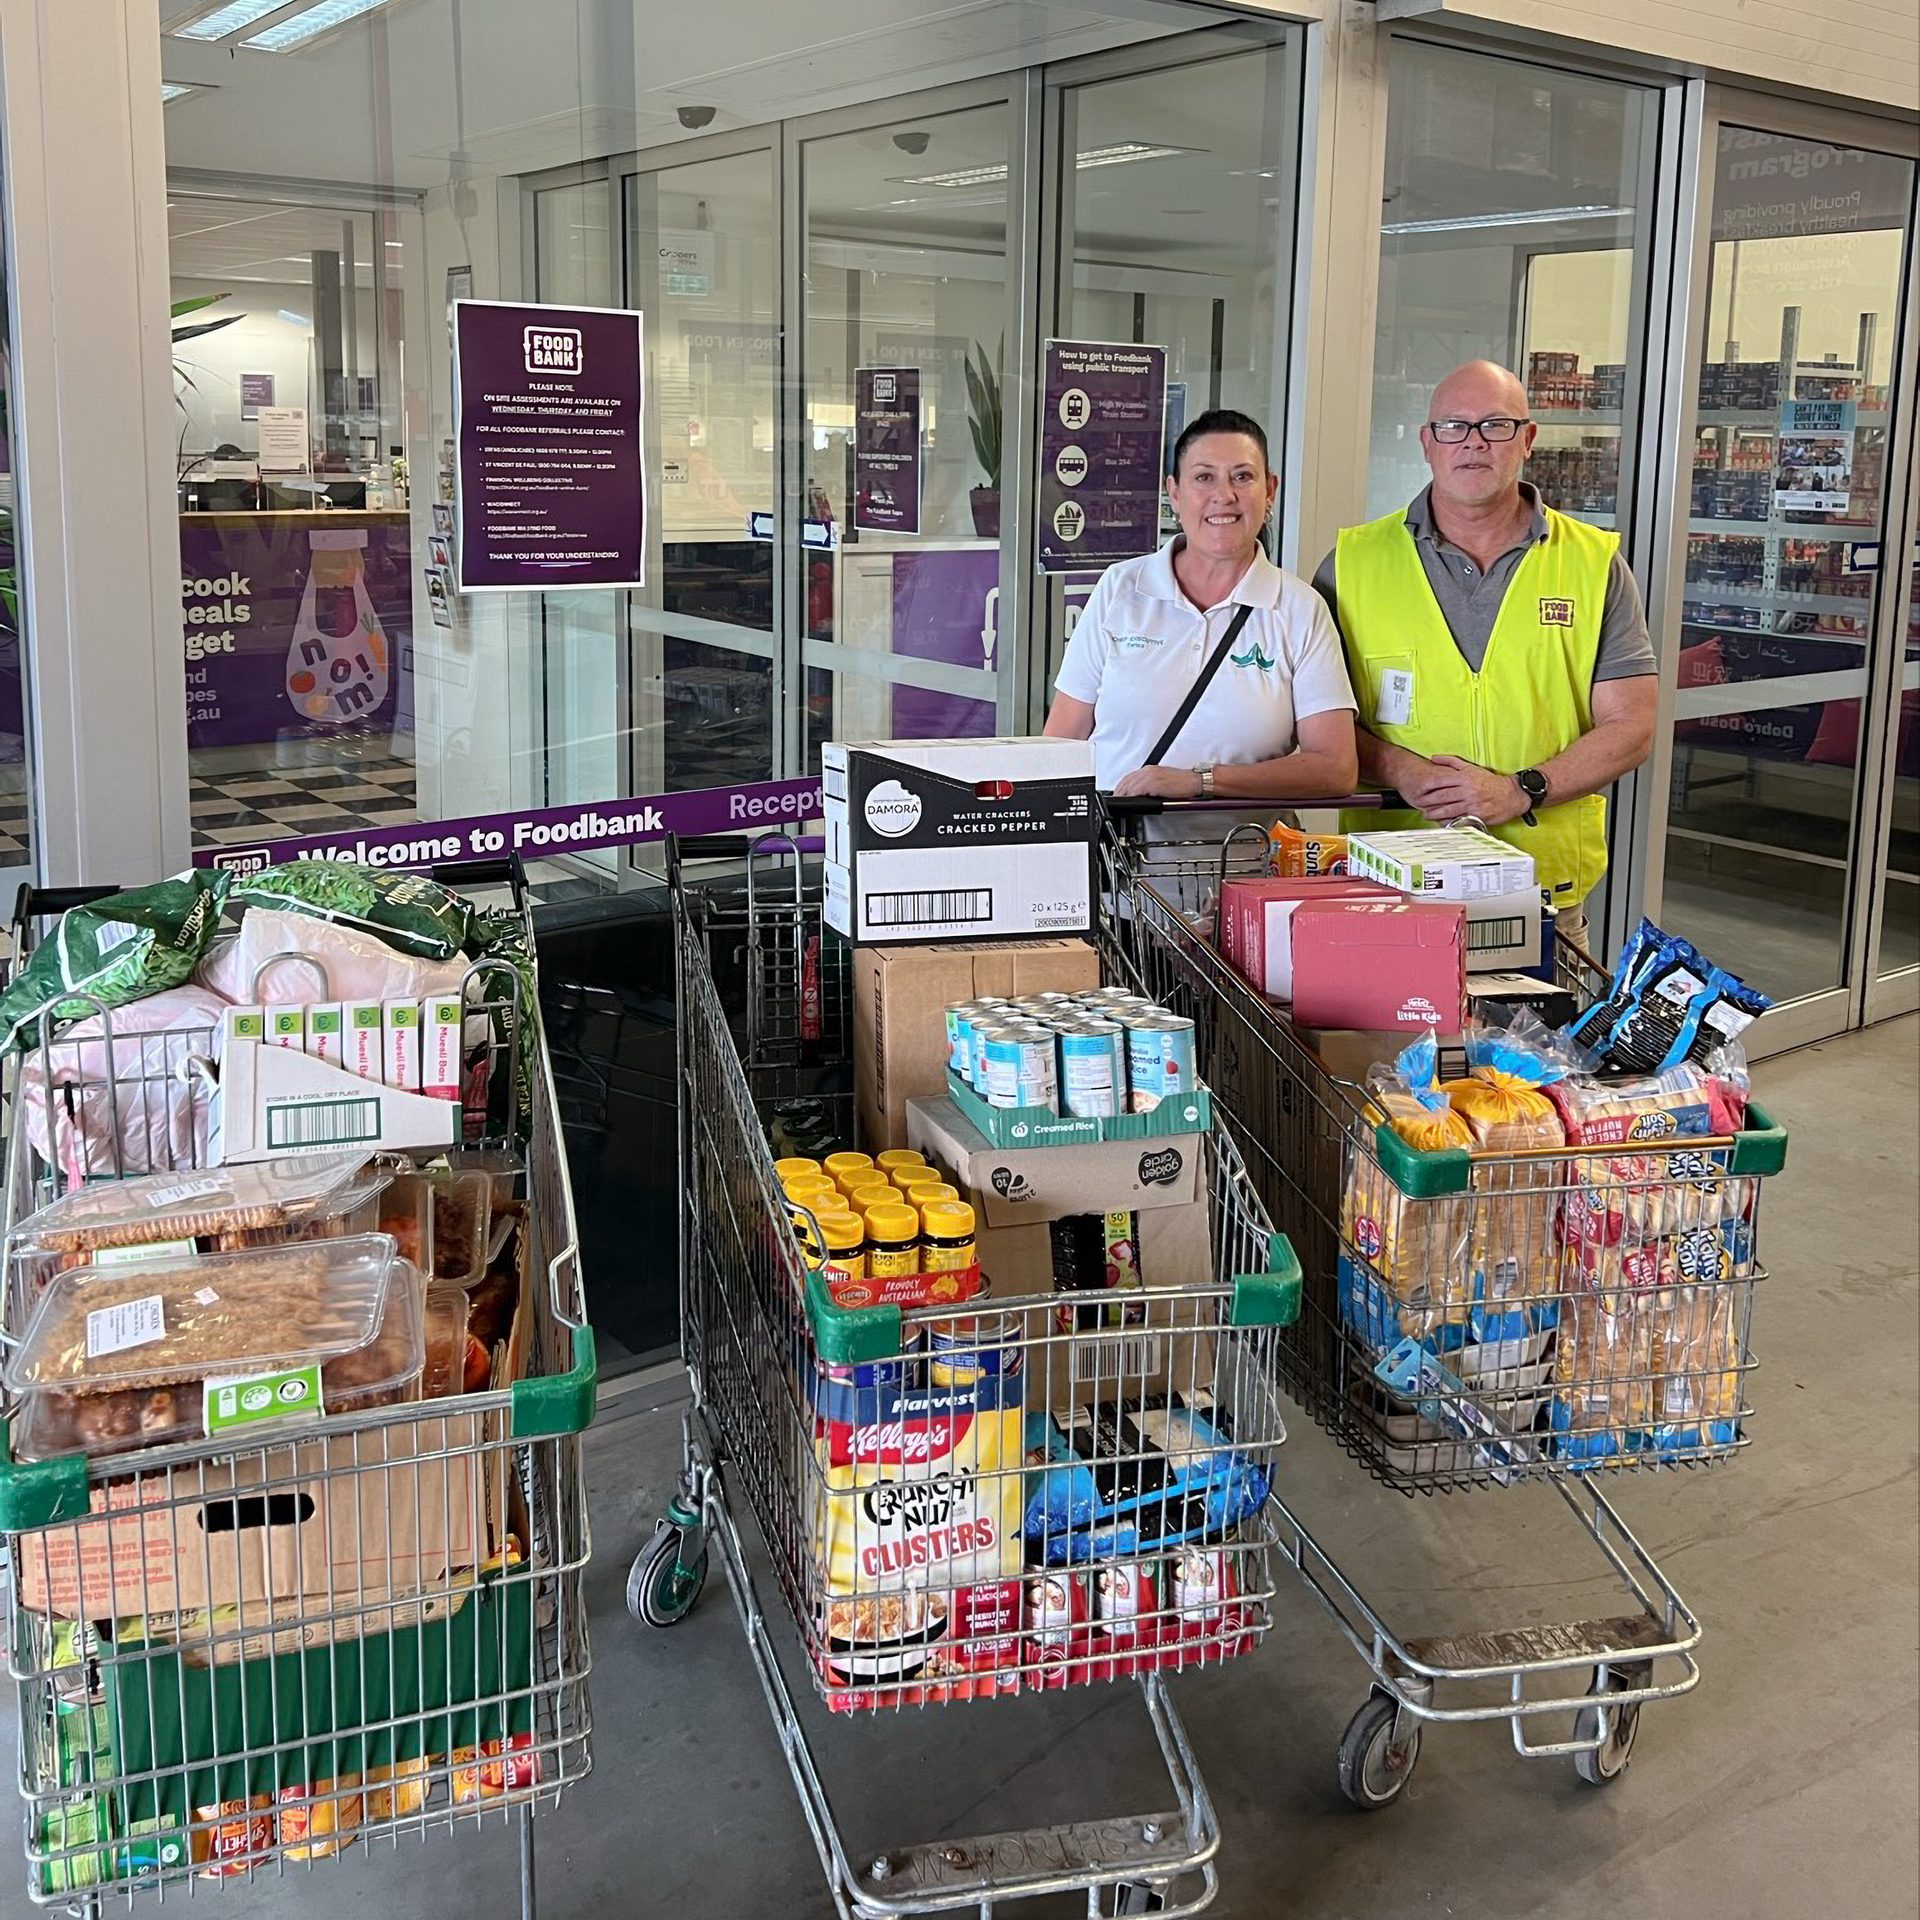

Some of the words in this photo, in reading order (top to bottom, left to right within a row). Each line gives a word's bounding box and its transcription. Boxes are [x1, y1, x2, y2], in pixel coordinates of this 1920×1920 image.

[533, 335, 573, 351] FOOD
[534, 350, 574, 367] BANK
[1059, 350, 1078, 359] How
[1079, 351, 1088, 360] to
[1089, 352, 1102, 362] get
[1104, 353, 1112, 361] to
[1114, 353, 1152, 363] Foodbank
[1062, 362, 1084, 373] using
[1085, 362, 1110, 373] public
[1111, 364, 1148, 375] transport
[181, 572, 251, 597] cook
[182, 599, 250, 625] eals
[1544, 602, 1568, 613] FOOD
[1545, 612, 1569, 622] BANK
[867, 804, 919, 815] DAMORA
[953, 812, 982, 820] WATER
[986, 810, 1031, 819] CRACKERS
[469, 828, 504, 853] to
[513, 806, 664, 847] Foodbank
[937, 823, 996, 834] CRACKED
[1001, 821, 1046, 832] PEPPER
[222, 856, 262, 872] FOOD
[1032, 903, 1044, 912] 20
[1054, 902, 1069, 911] 125
[1397, 1010, 1421, 1021] Little
[1421, 1011, 1442, 1024] Kids
[440, 1026, 449, 1061] Muesli
[1132, 1055, 1161, 1065] amed
[438, 1061, 448, 1083] Bars
[1034, 1124, 1074, 1134] Creamed
[1075, 1122, 1095, 1132] Rice
[1141, 1157, 1180, 1179] golden
[1144, 1153, 1173, 1168] circle
[885, 1279, 921, 1291] PROUDLY
[878, 1289, 926, 1303] AUSTRALIAN
[891, 1390, 976, 1414] Harvest
[848, 1421, 950, 1457] Kellogg's
[864, 1464, 981, 1526] CRUNCHY
[903, 1499, 956, 1532] NUT
[862, 1517, 994, 1577] CLUSTERS
